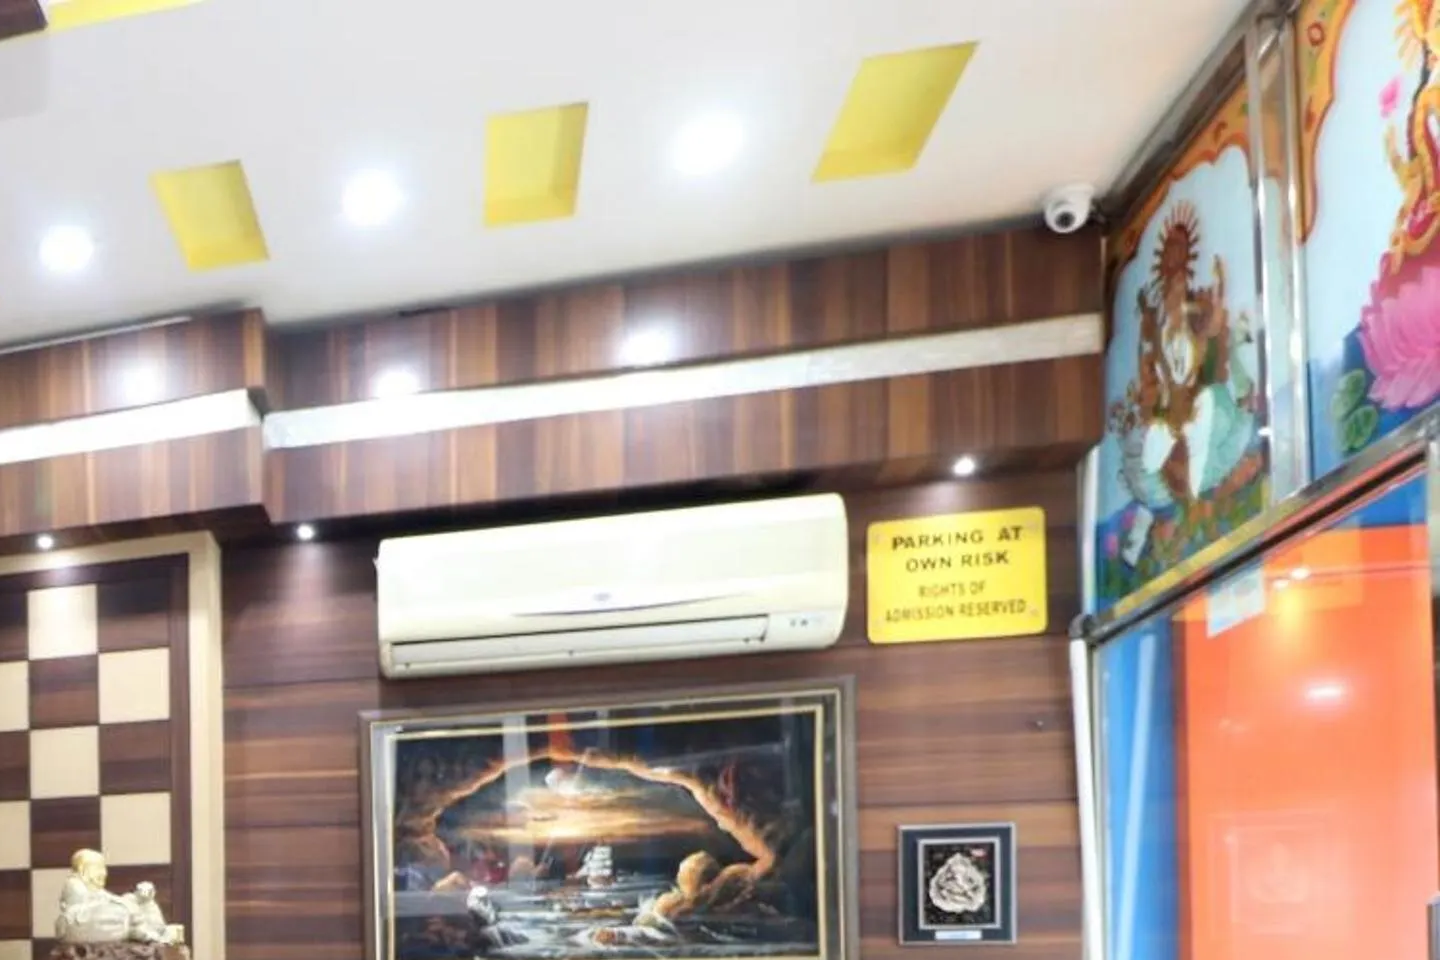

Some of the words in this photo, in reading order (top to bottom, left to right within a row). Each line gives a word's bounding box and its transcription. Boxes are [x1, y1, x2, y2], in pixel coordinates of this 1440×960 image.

[892, 529, 984, 551] PARKING
[997, 525, 1023, 541] AT
[905, 556, 952, 572] OWN
[961, 550, 1010, 567] RISK
[918, 582, 966, 598] RIGHTS
[969, 580, 986, 595] OF
[885, 604, 955, 622] ADMISSION
[959, 598, 1028, 617] RESERVED
